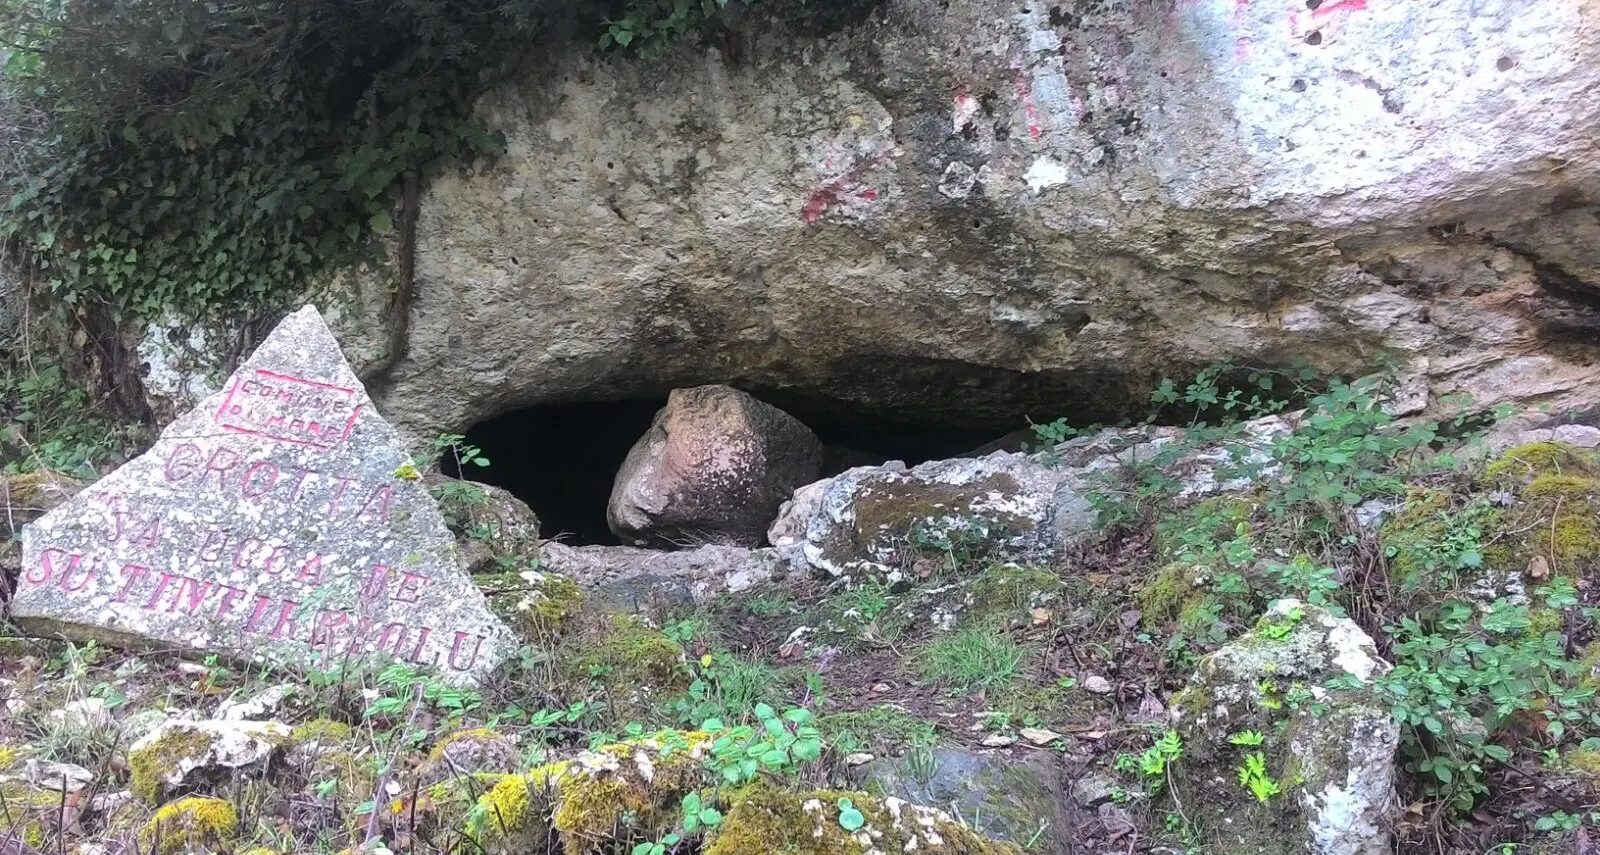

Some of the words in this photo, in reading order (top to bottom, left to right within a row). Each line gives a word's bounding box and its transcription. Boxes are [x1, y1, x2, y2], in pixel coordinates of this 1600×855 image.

[241, 380, 345, 413] COMUNE
[164, 443, 392, 521] GROTTA
[25, 547, 97, 592] SU
[199, 528, 323, 586] UCCA
